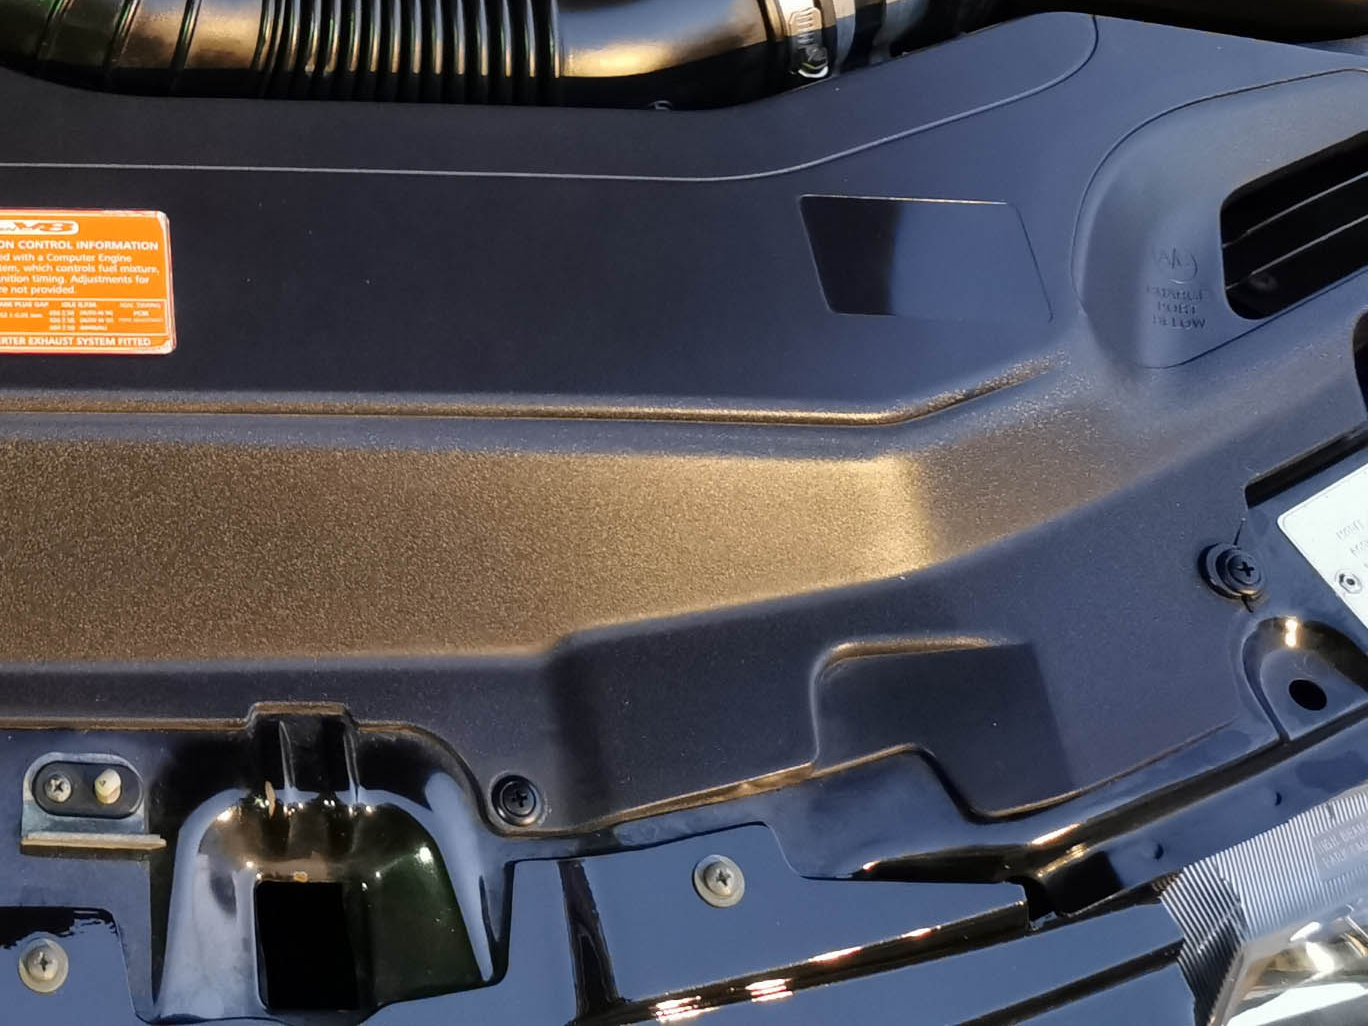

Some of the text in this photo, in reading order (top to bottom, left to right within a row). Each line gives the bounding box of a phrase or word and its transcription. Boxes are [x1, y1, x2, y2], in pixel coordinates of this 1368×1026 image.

[18, 240, 73, 250] CONTROL
[77, 240, 159, 250] INFORMATION
[13, 252, 34, 263] with
[37, 252, 43, 263] a
[46, 252, 94, 263] Computer
[98, 252, 132, 263] Engine
[23, 263, 52, 273] which
[55, 263, 95, 273] controls
[98, 263, 117, 273] fuel
[120, 263, 160, 273] mixture,
[32, 274, 67, 284] timing.
[71, 274, 132, 284] Adjustments
[135, 274, 149, 284] for
[10, 285, 27, 295] not
[30, 285, 76, 295] provided.
[28, 336, 74, 346] EXHAUST
[77, 336, 115, 346] SYSTEM
[119, 336, 151, 346] FITTED
